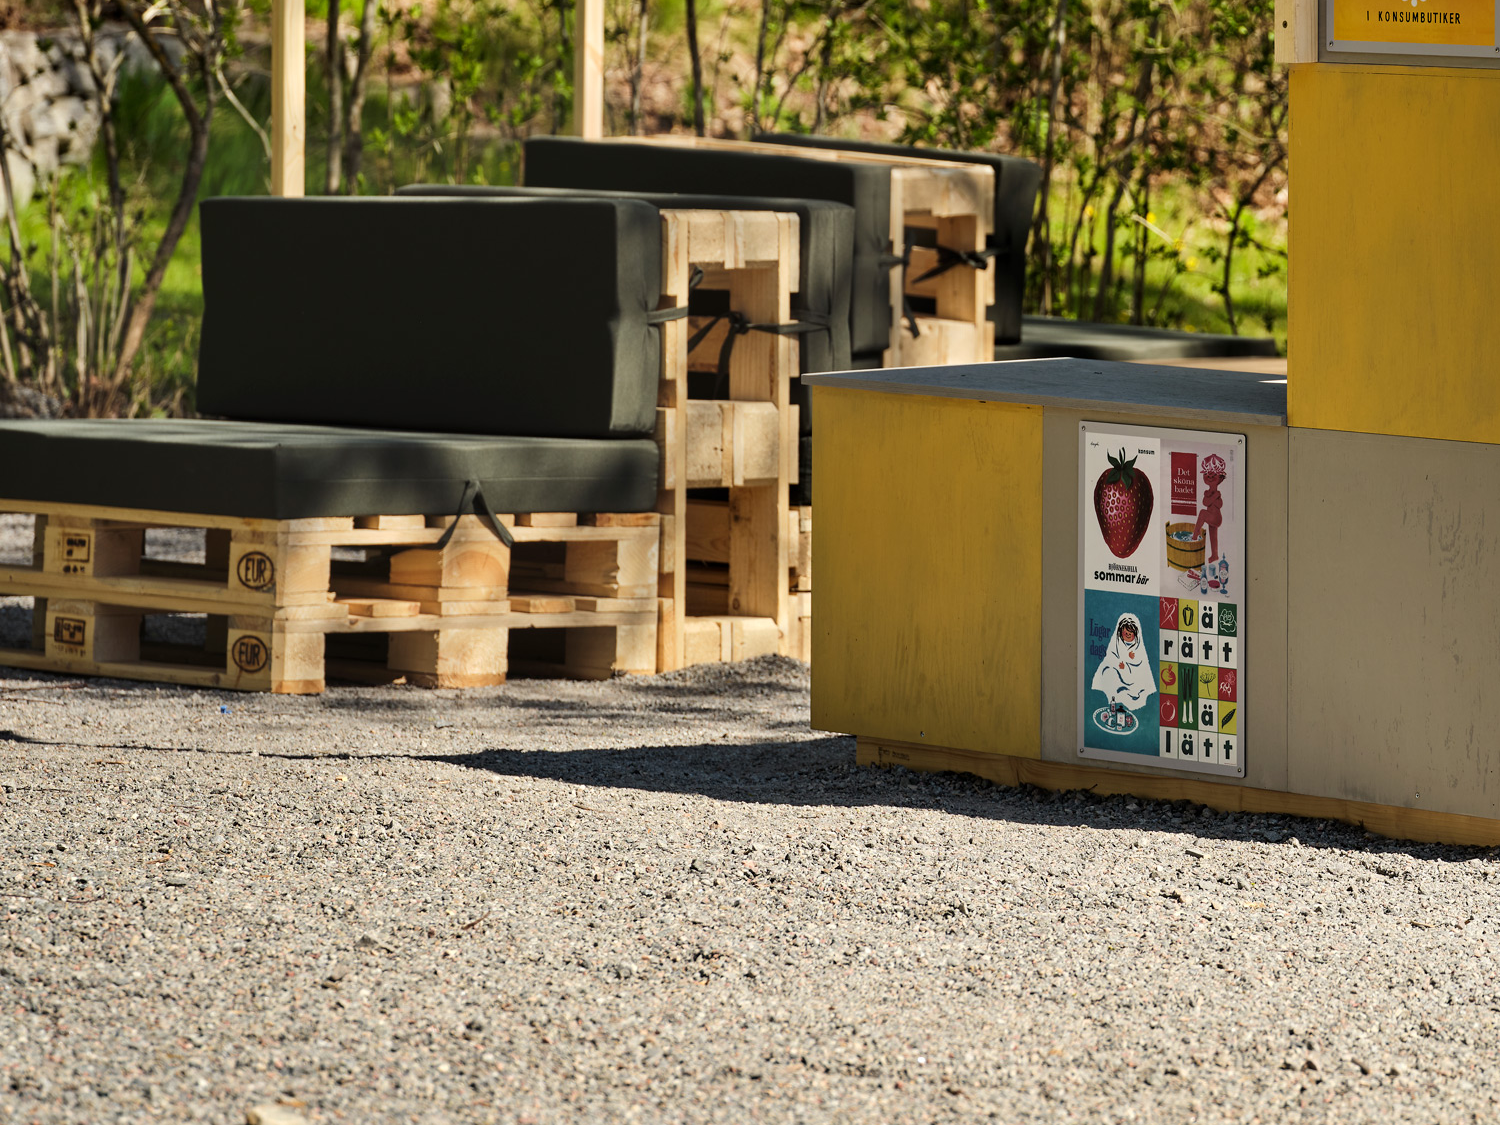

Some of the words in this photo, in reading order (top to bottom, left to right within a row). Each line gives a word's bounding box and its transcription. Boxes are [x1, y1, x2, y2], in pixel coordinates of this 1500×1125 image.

[1378, 11, 1461, 24] KONSUMBUTIKER
[1173, 476, 1195, 485] sköna
[1177, 467, 1190, 476] Det
[1174, 485, 1193, 494] badet
[245, 558, 266, 584] EUR
[1094, 570, 1136, 583] sommar
[1136, 574, 1150, 585] bör
[1201, 606, 1213, 629] ä
[1089, 618, 1111, 641] Lögar
[238, 644, 261, 672] EUR
[1201, 704, 1213, 726] ä
